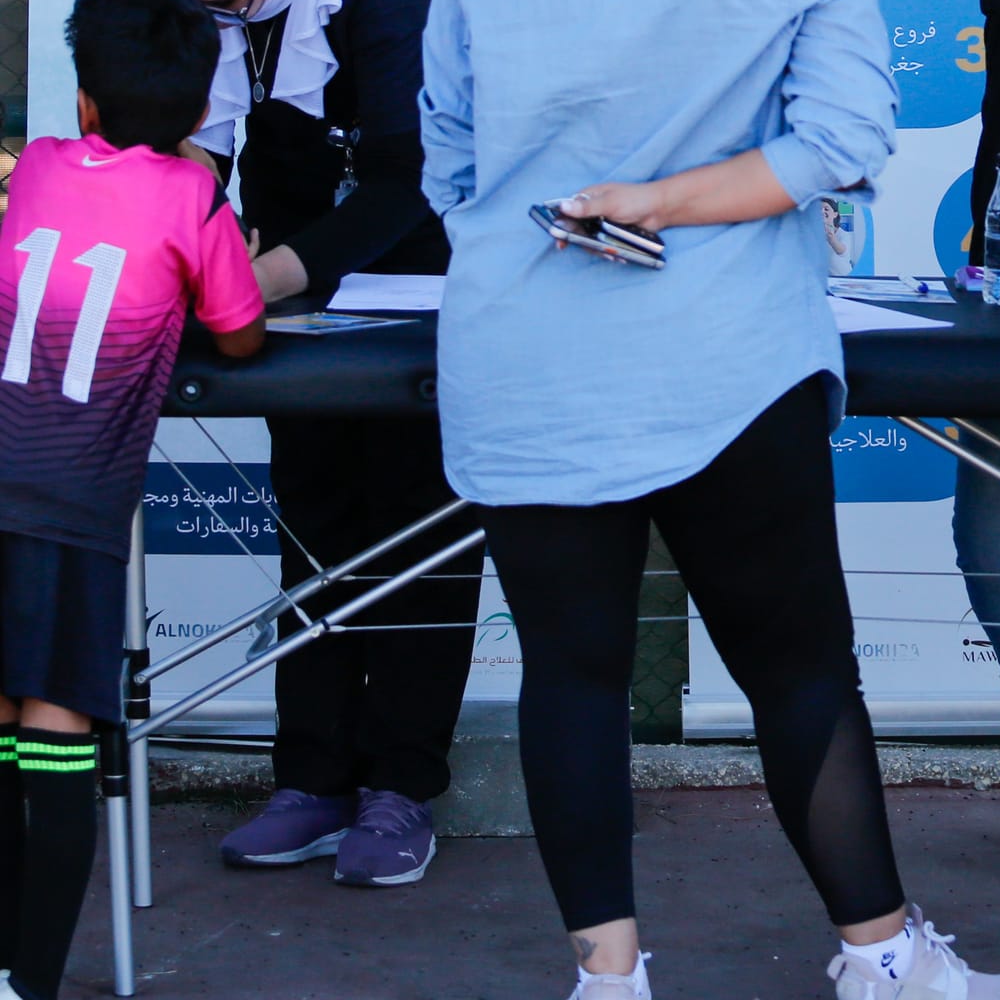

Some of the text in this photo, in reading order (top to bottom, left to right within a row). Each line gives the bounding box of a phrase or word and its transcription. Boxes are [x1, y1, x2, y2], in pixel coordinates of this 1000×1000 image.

[892, 20, 936, 48] فروع
[954, 25, 986, 72] 3
[1, 227, 127, 403] 11
[961, 650, 998, 663] MAW
